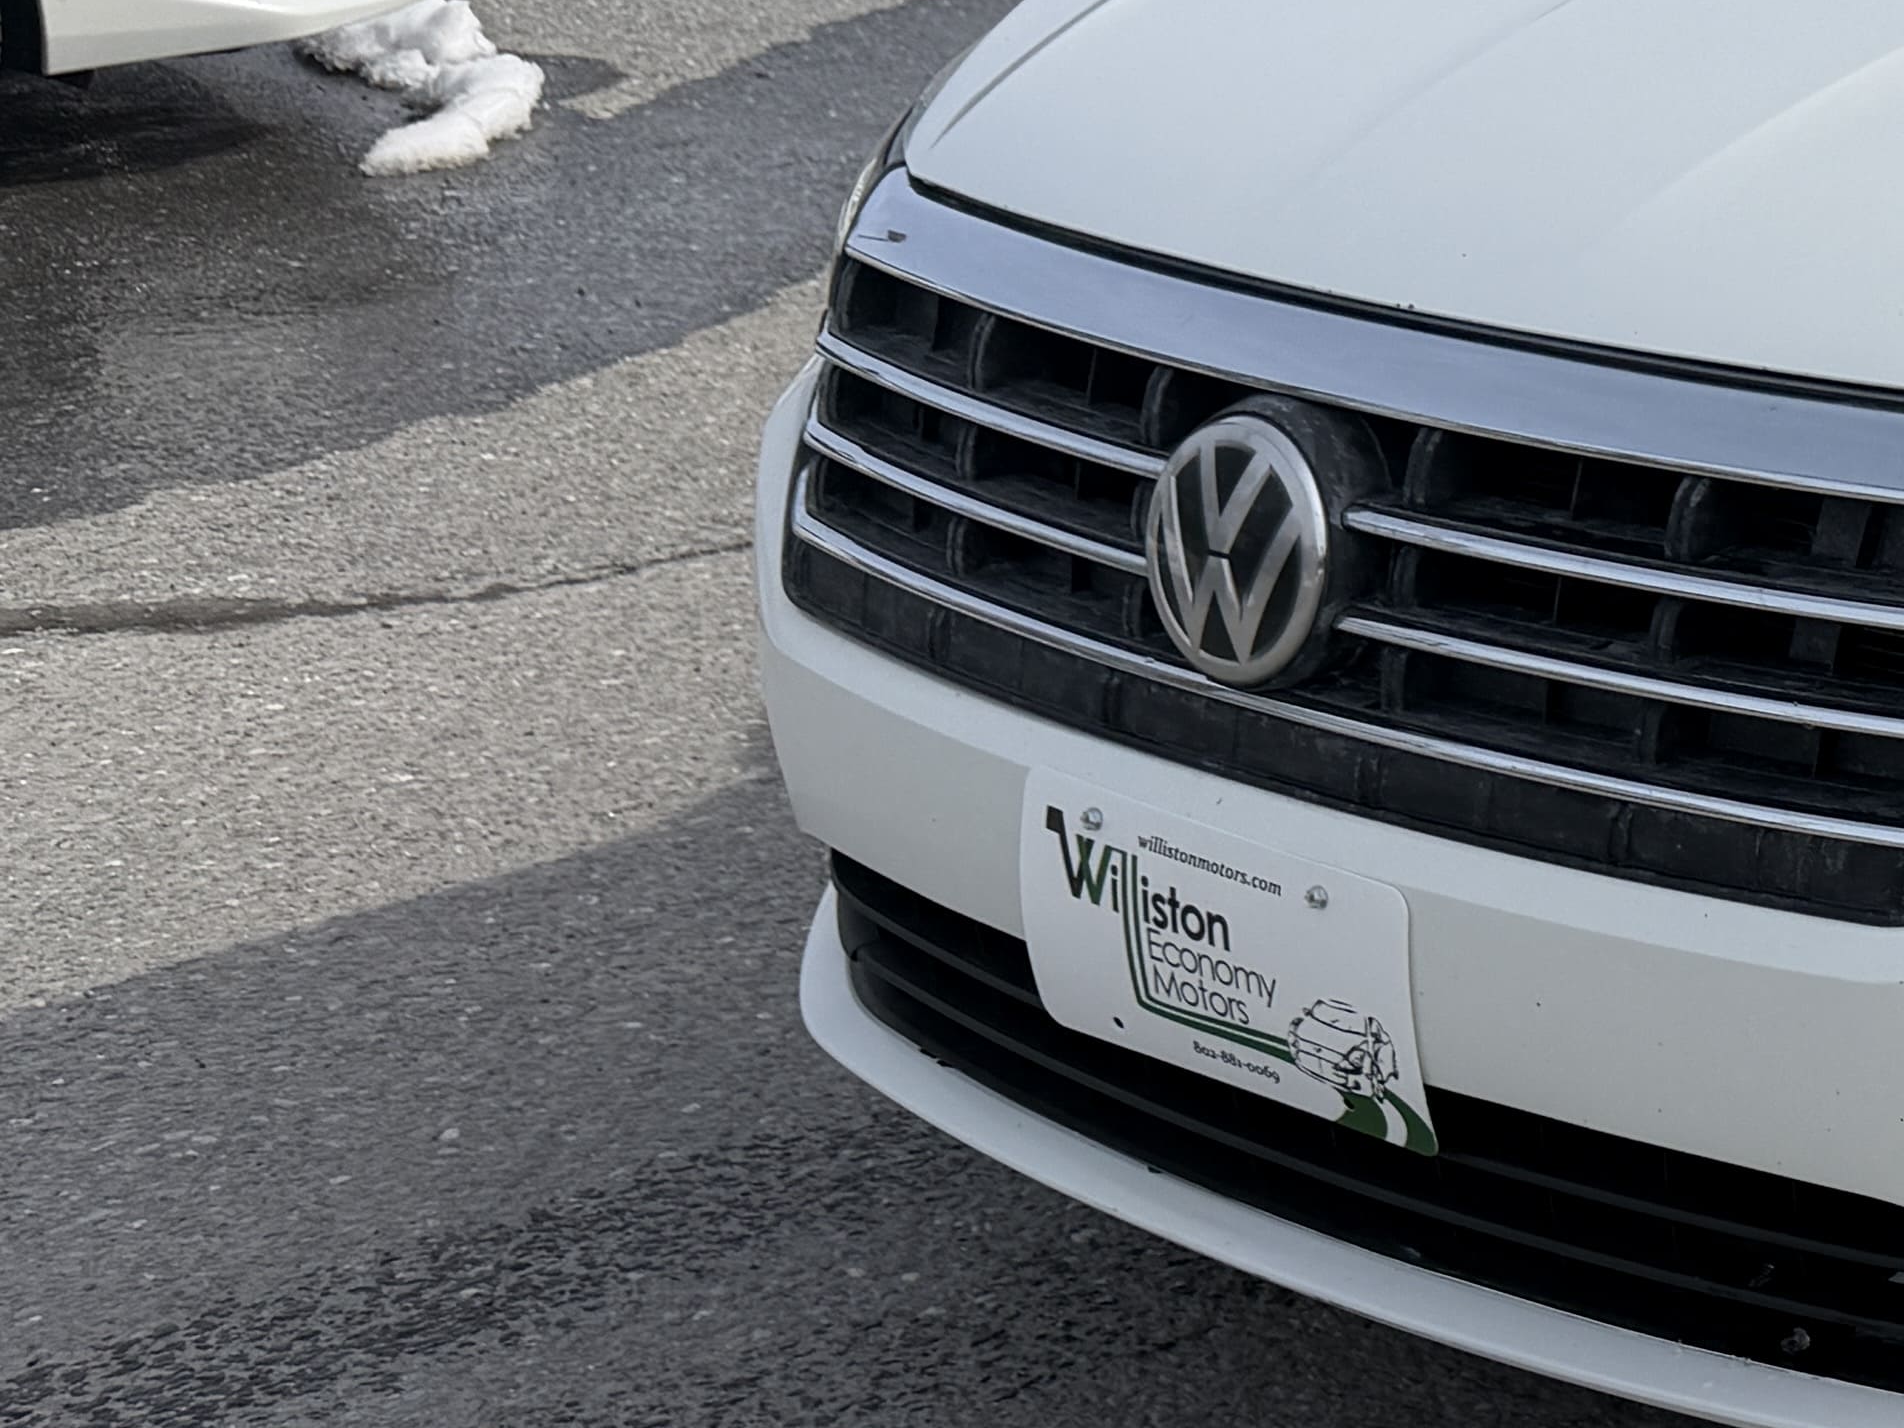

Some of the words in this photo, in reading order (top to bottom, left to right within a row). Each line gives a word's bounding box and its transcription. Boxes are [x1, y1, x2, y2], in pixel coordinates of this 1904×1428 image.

[1046, 805, 1231, 952] Williston
[1137, 835, 1282, 897] willistonmotors.com
[1147, 927, 1276, 1008] Economy
[1153, 963, 1250, 1025] Motors
